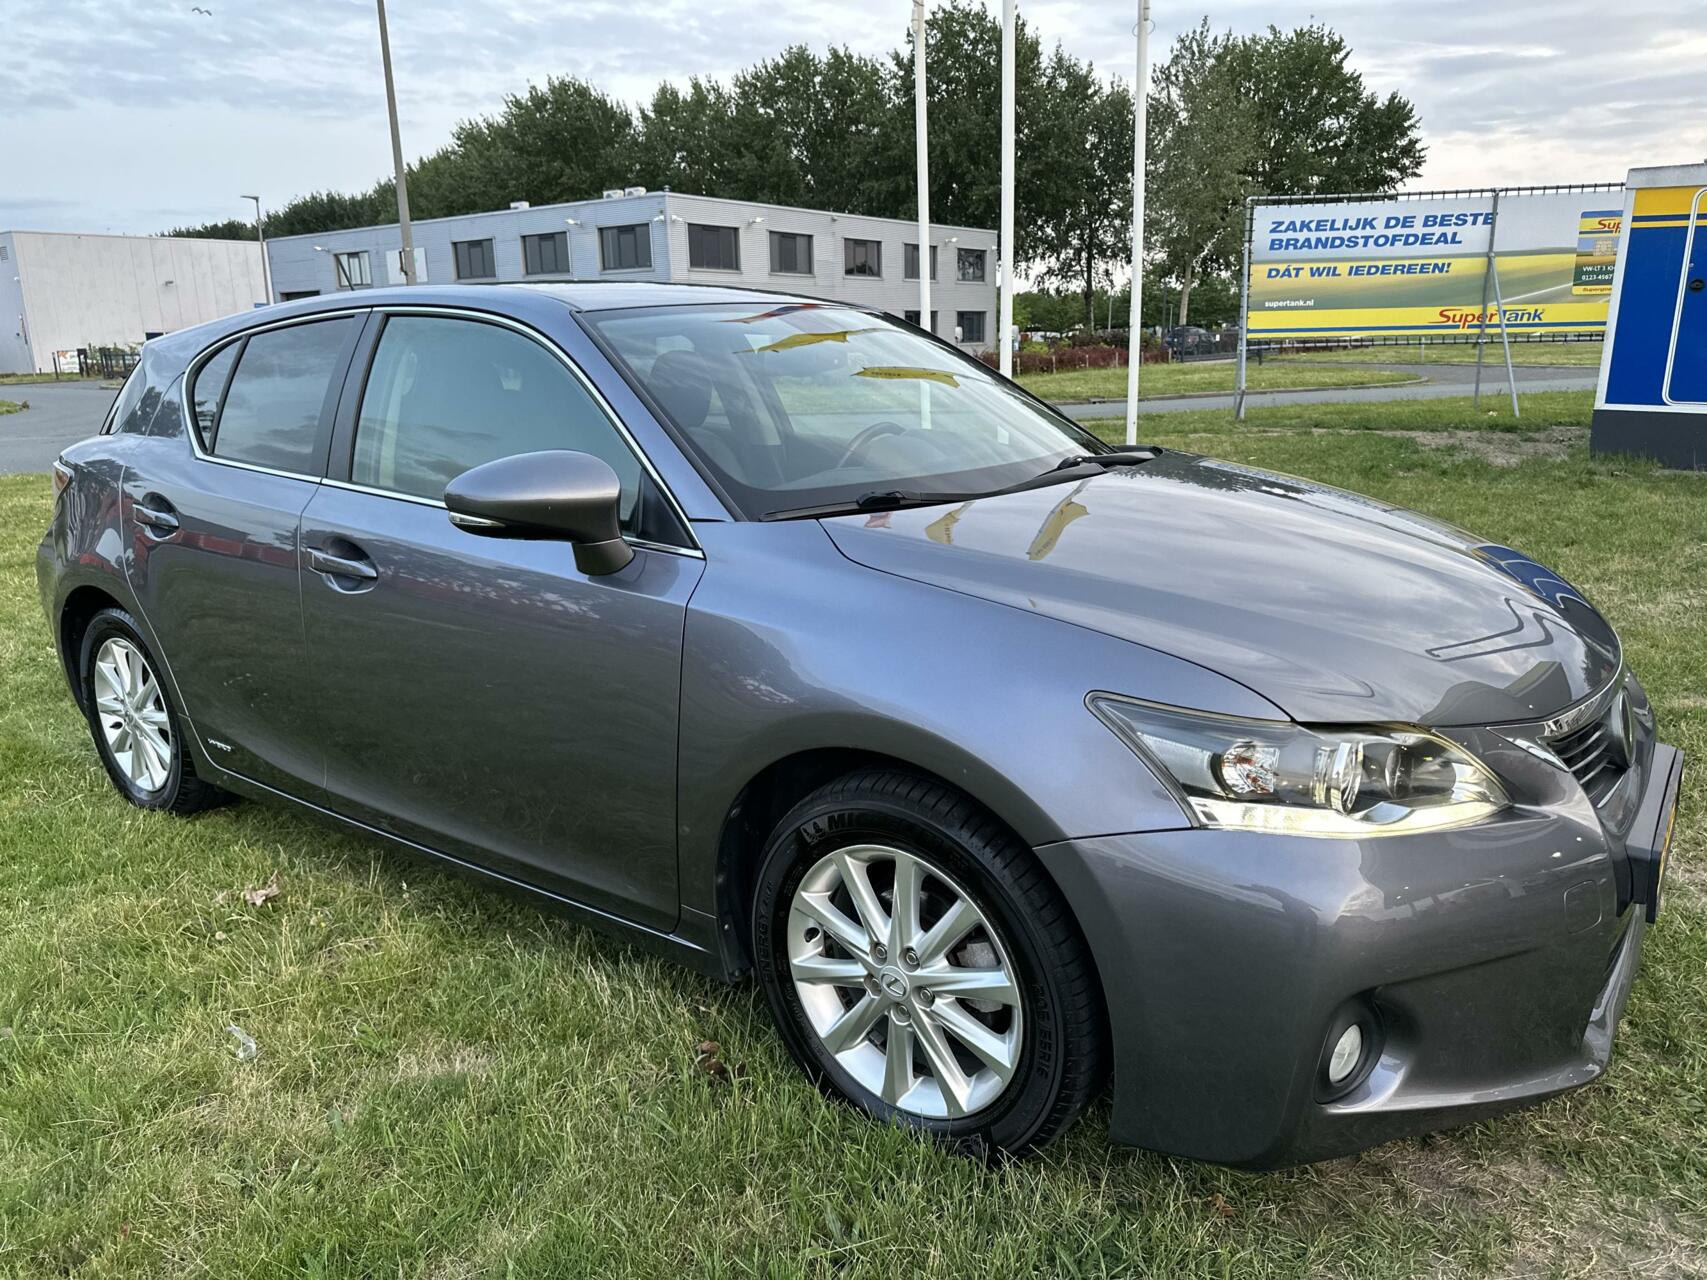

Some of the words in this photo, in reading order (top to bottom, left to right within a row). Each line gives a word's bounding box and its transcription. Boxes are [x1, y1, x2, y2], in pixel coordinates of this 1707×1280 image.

[1269, 217, 1379, 234] ZAKELIJK
[1384, 215, 1416, 230] DE
[1422, 212, 1498, 228] BESTE
[1269, 231, 1463, 251] BRANDSTOFDEAL
[1267, 264, 1304, 279] DÁT
[1309, 266, 1341, 278] WIL
[1348, 262, 1452, 276] IEDEREEN!
[1265, 299, 1315, 308] supertank.nl
